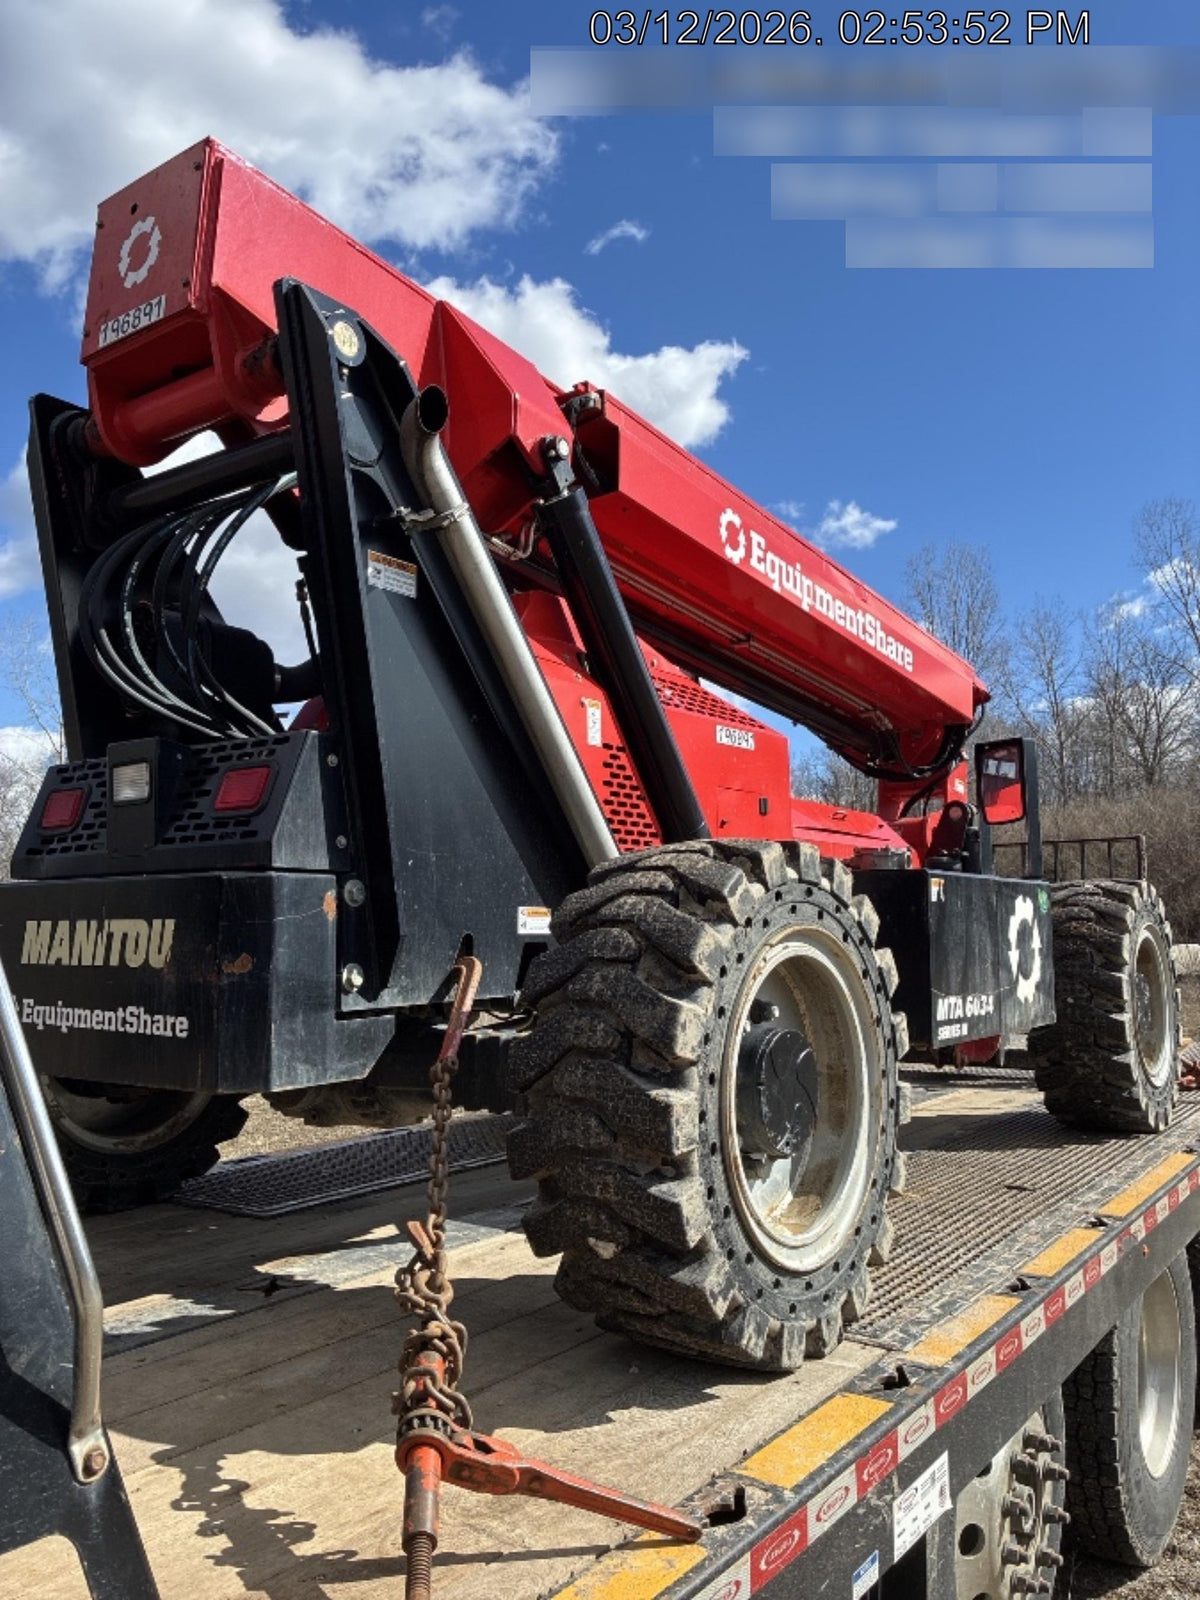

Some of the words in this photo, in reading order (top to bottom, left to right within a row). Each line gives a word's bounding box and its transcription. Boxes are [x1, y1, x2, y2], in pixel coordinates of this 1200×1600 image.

[102, 296, 163, 344] 196891
[750, 530, 913, 672] EquipmentShare
[21, 919, 176, 968] MANITOU
[22, 998, 189, 1038] EquipmentShare
[936, 996, 964, 1021] MTA
